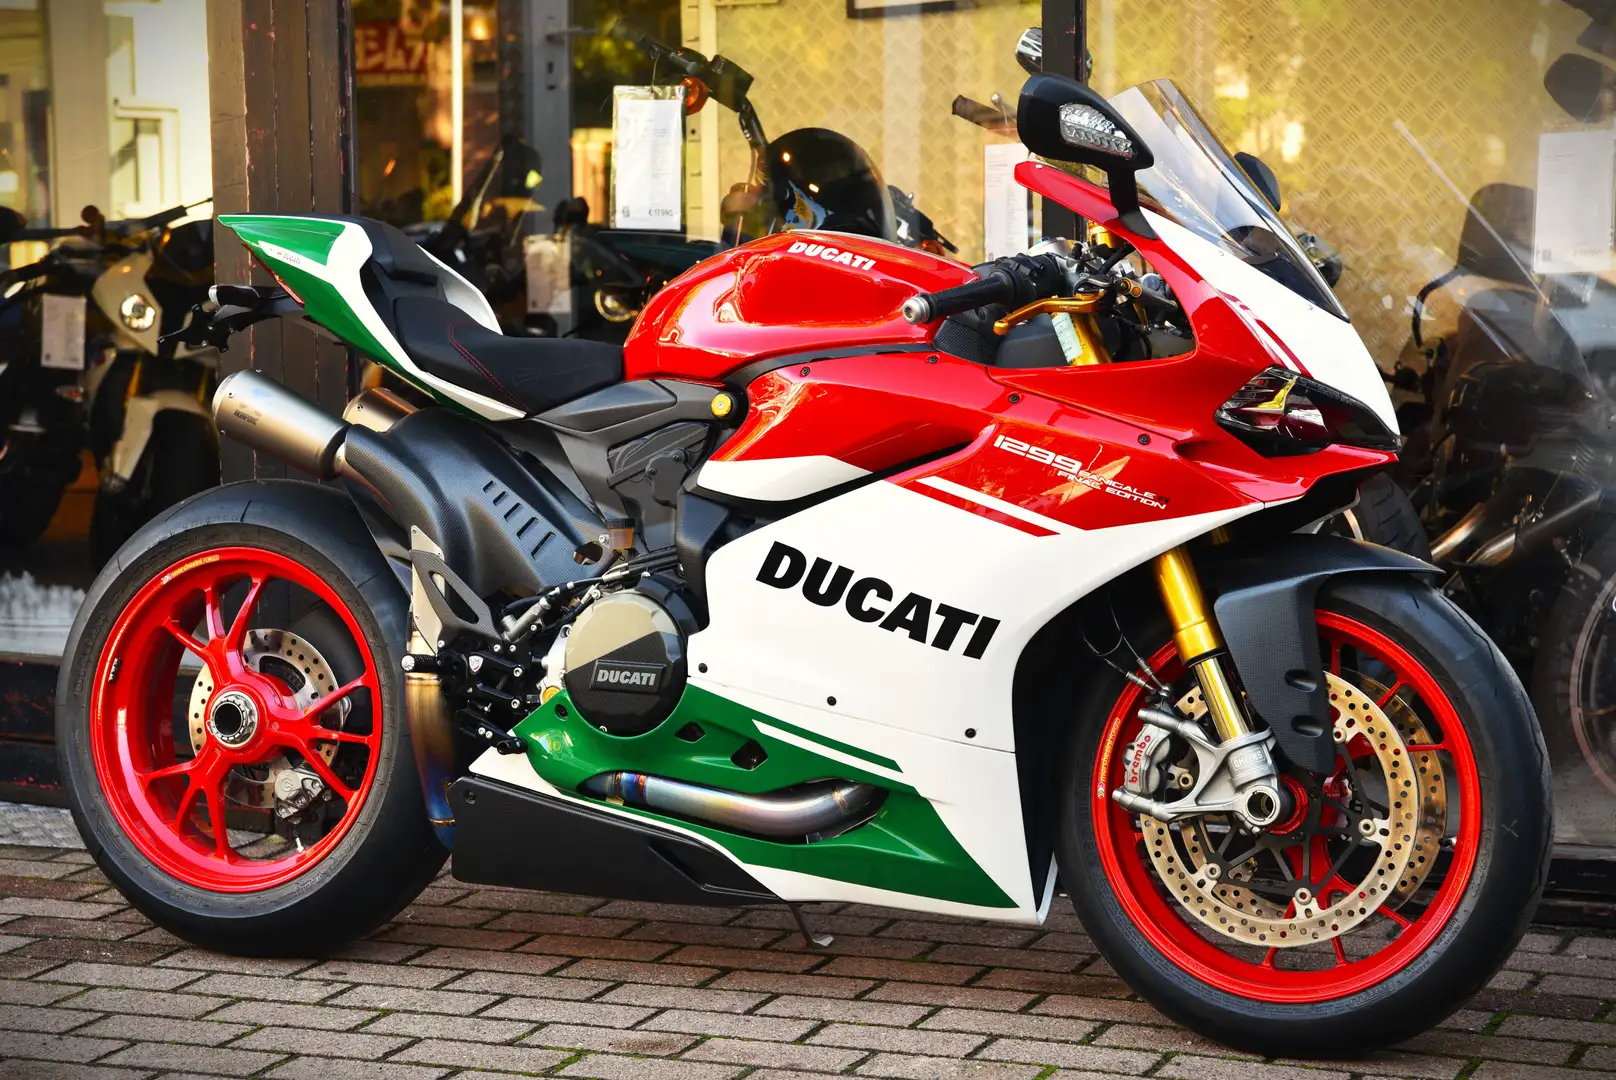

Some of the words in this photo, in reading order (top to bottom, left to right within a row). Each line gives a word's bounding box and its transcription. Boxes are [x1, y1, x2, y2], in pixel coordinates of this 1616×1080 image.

[787, 241, 876, 271] DUCATI
[993, 434, 1082, 475] 1299
[1057, 470, 1101, 490] FINAL
[1105, 486, 1166, 510] EDITION
[756, 541, 1000, 660] DUCATI
[597, 670, 656, 685] DUCATI
[1129, 735, 1151, 784] brembo
